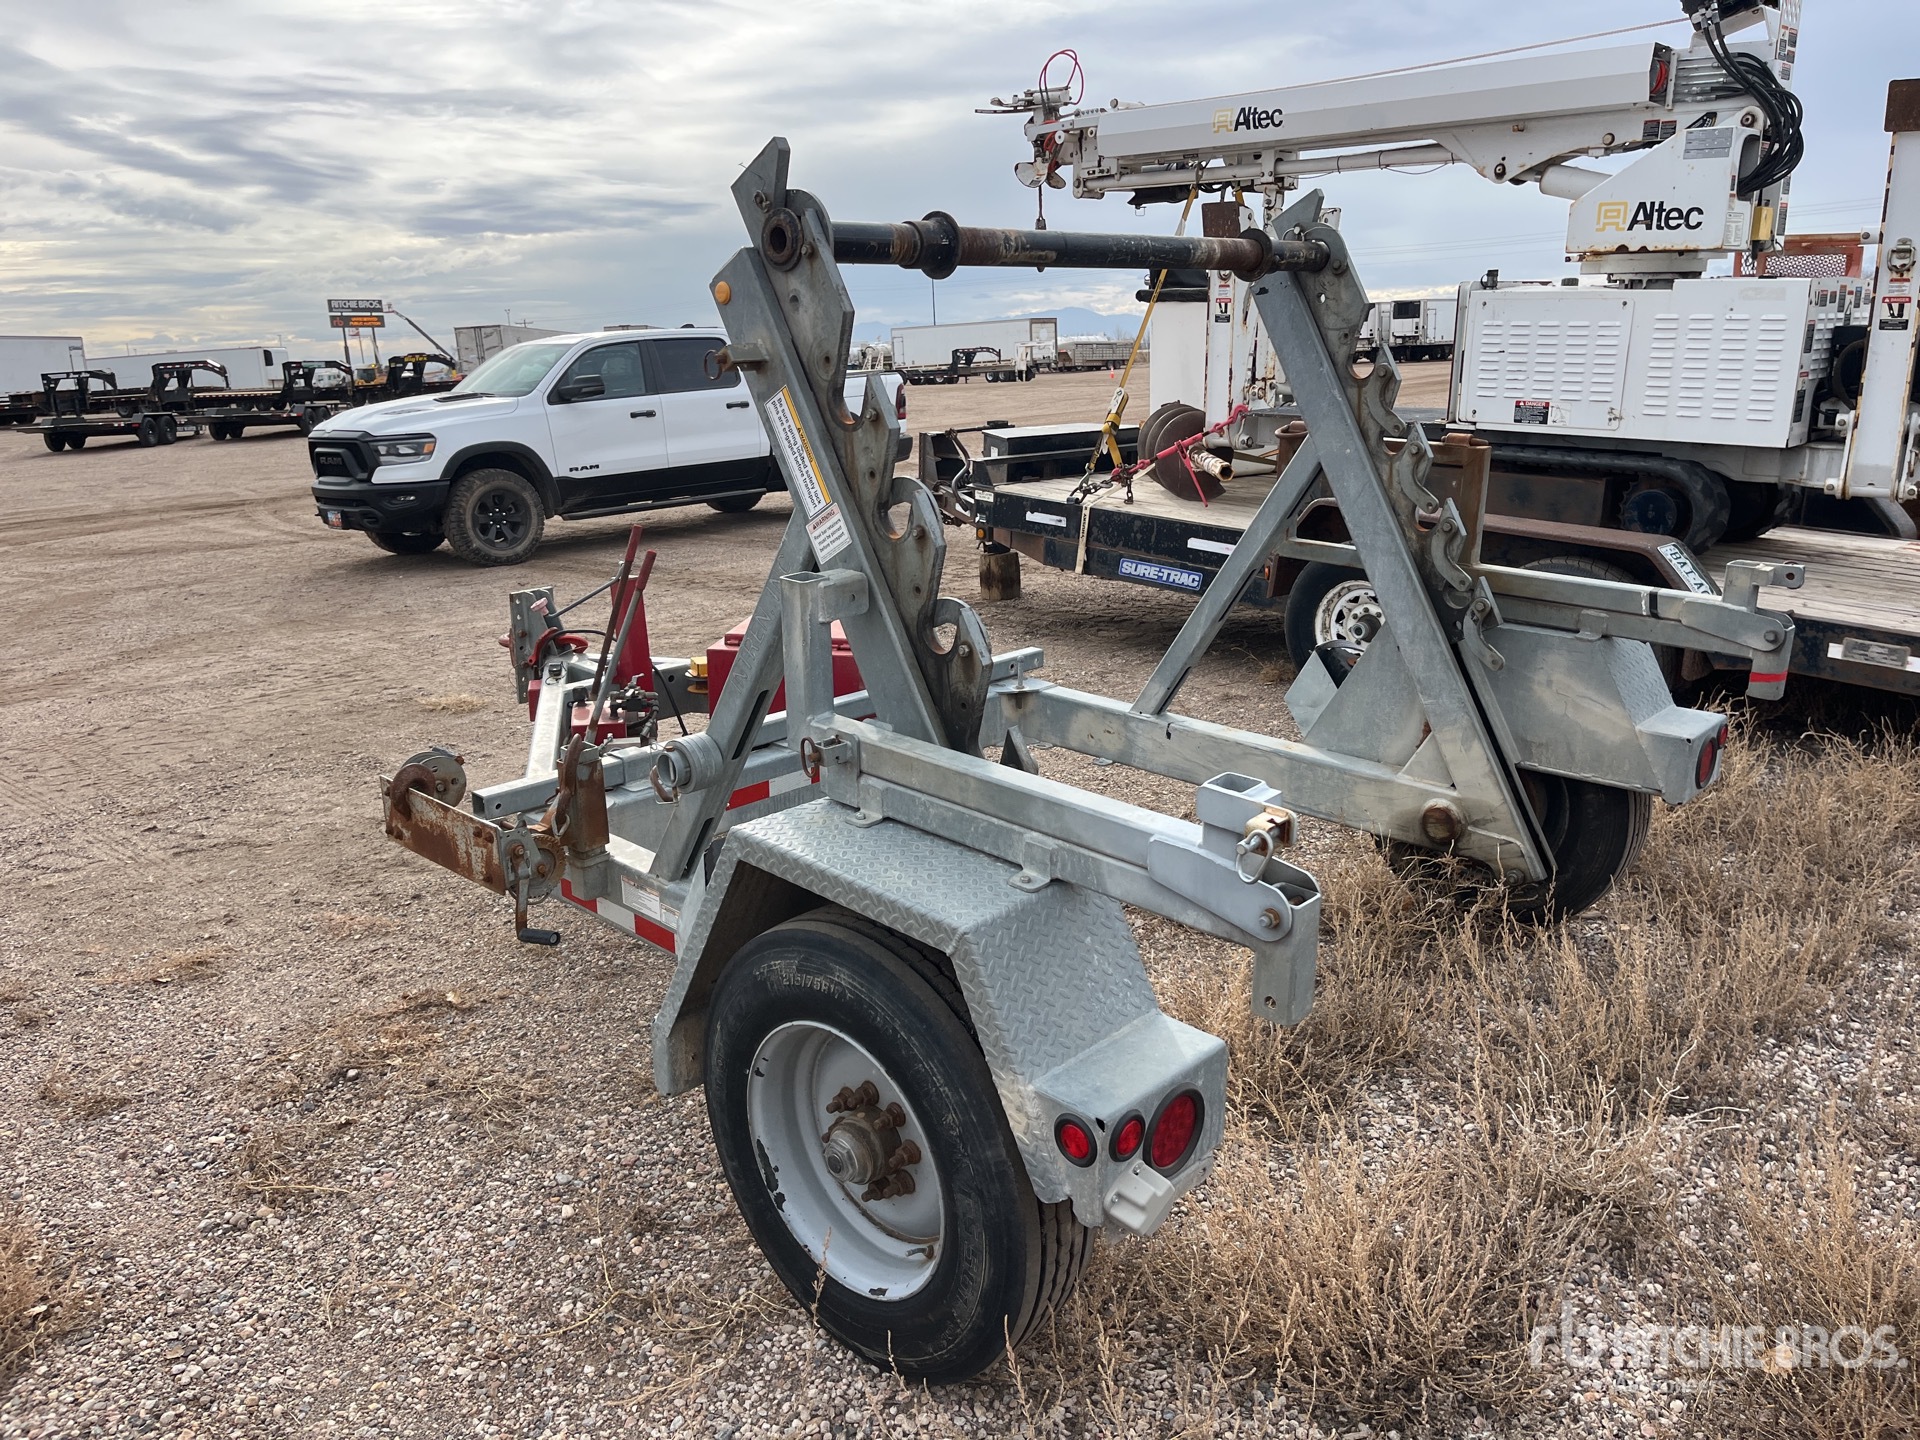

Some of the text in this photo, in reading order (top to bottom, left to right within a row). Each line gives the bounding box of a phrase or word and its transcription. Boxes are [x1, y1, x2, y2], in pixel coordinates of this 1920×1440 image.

[1233, 106, 1284, 132] Altec
[1626, 200, 1704, 231] Altec
[331, 300, 381, 308] RITCHIE BROS.
[770, 398, 780, 416] pins
[781, 426, 796, 457] engaged
[793, 455, 805, 478] before
[776, 396, 822, 506] Be sure spring loaded safety lock
[320, 457, 343, 466] RAM
[569, 464, 600, 472] RAM
[813, 508, 835, 528] WARNING
[1121, 561, 1200, 587] SURE-TRAC
